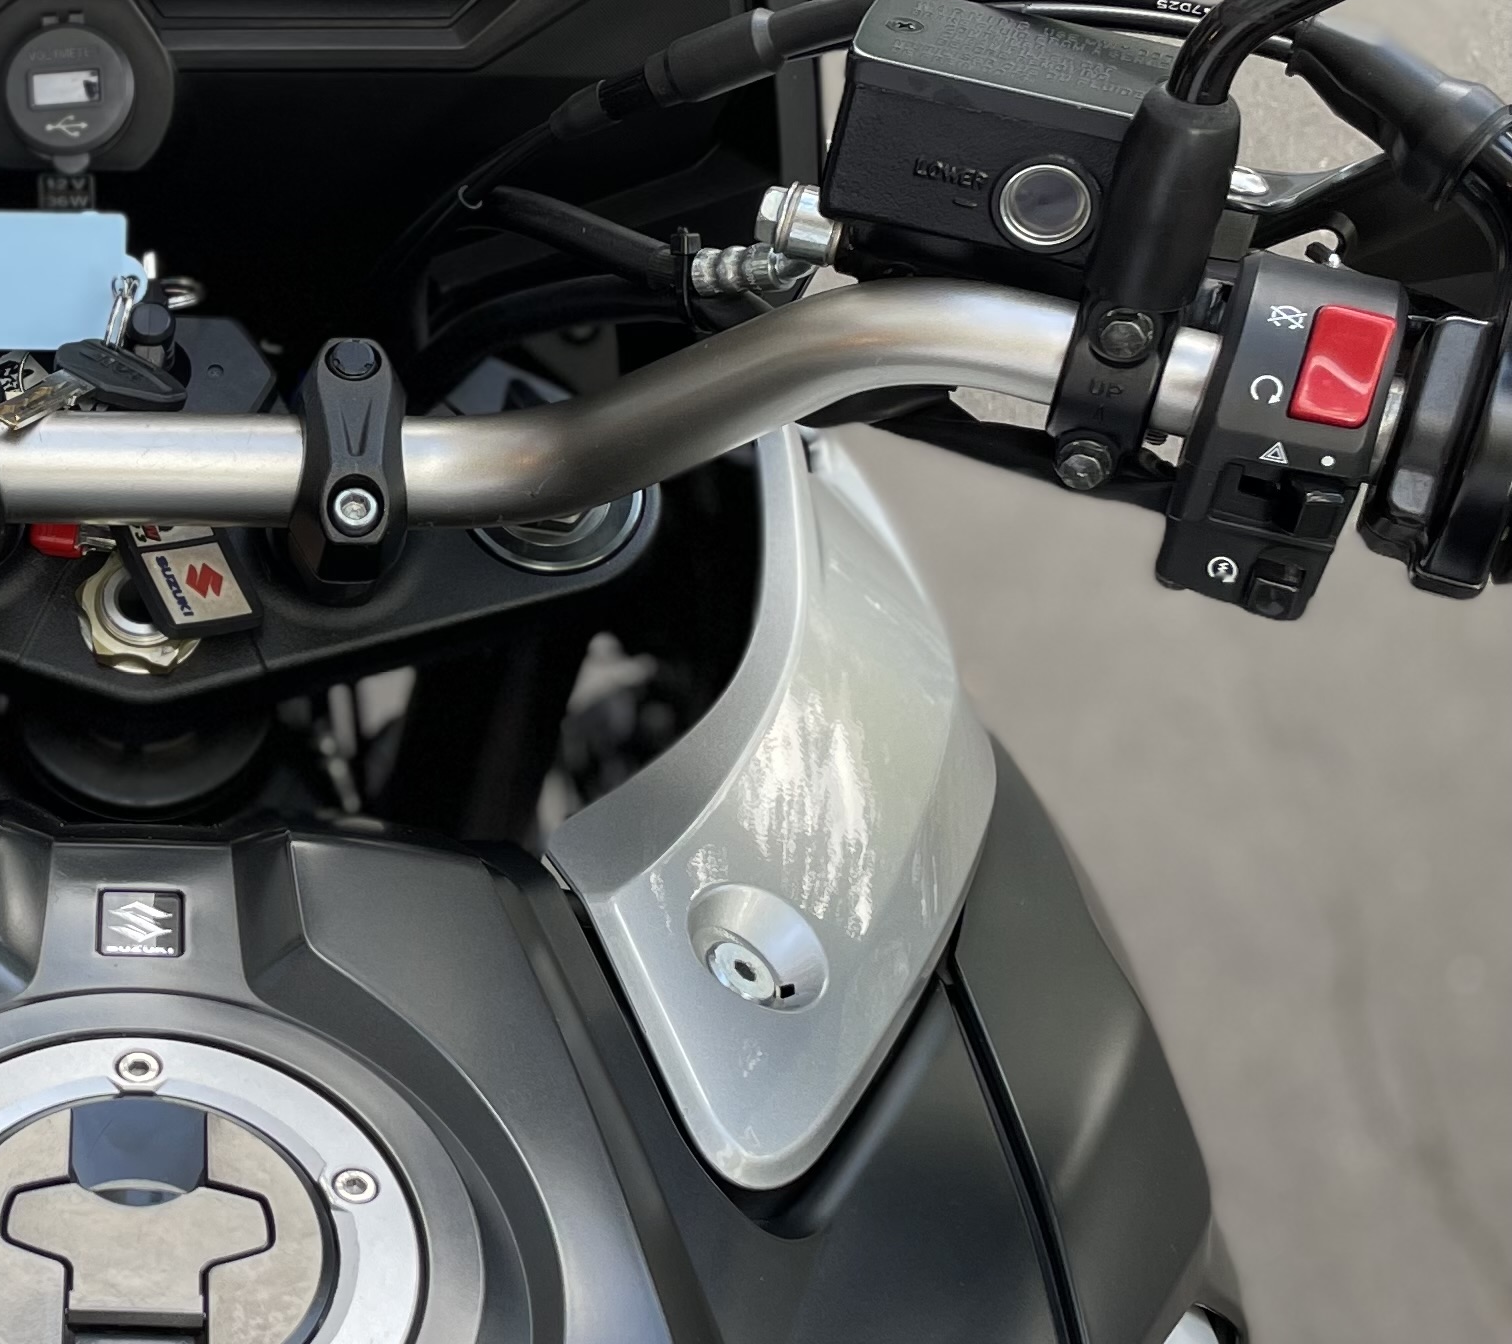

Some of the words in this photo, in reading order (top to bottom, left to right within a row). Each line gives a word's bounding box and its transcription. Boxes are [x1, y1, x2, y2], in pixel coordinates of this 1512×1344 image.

[913, 158, 988, 190] LOWER
[1089, 378, 1124, 398] UP
[155, 555, 195, 616] SUZUKI
